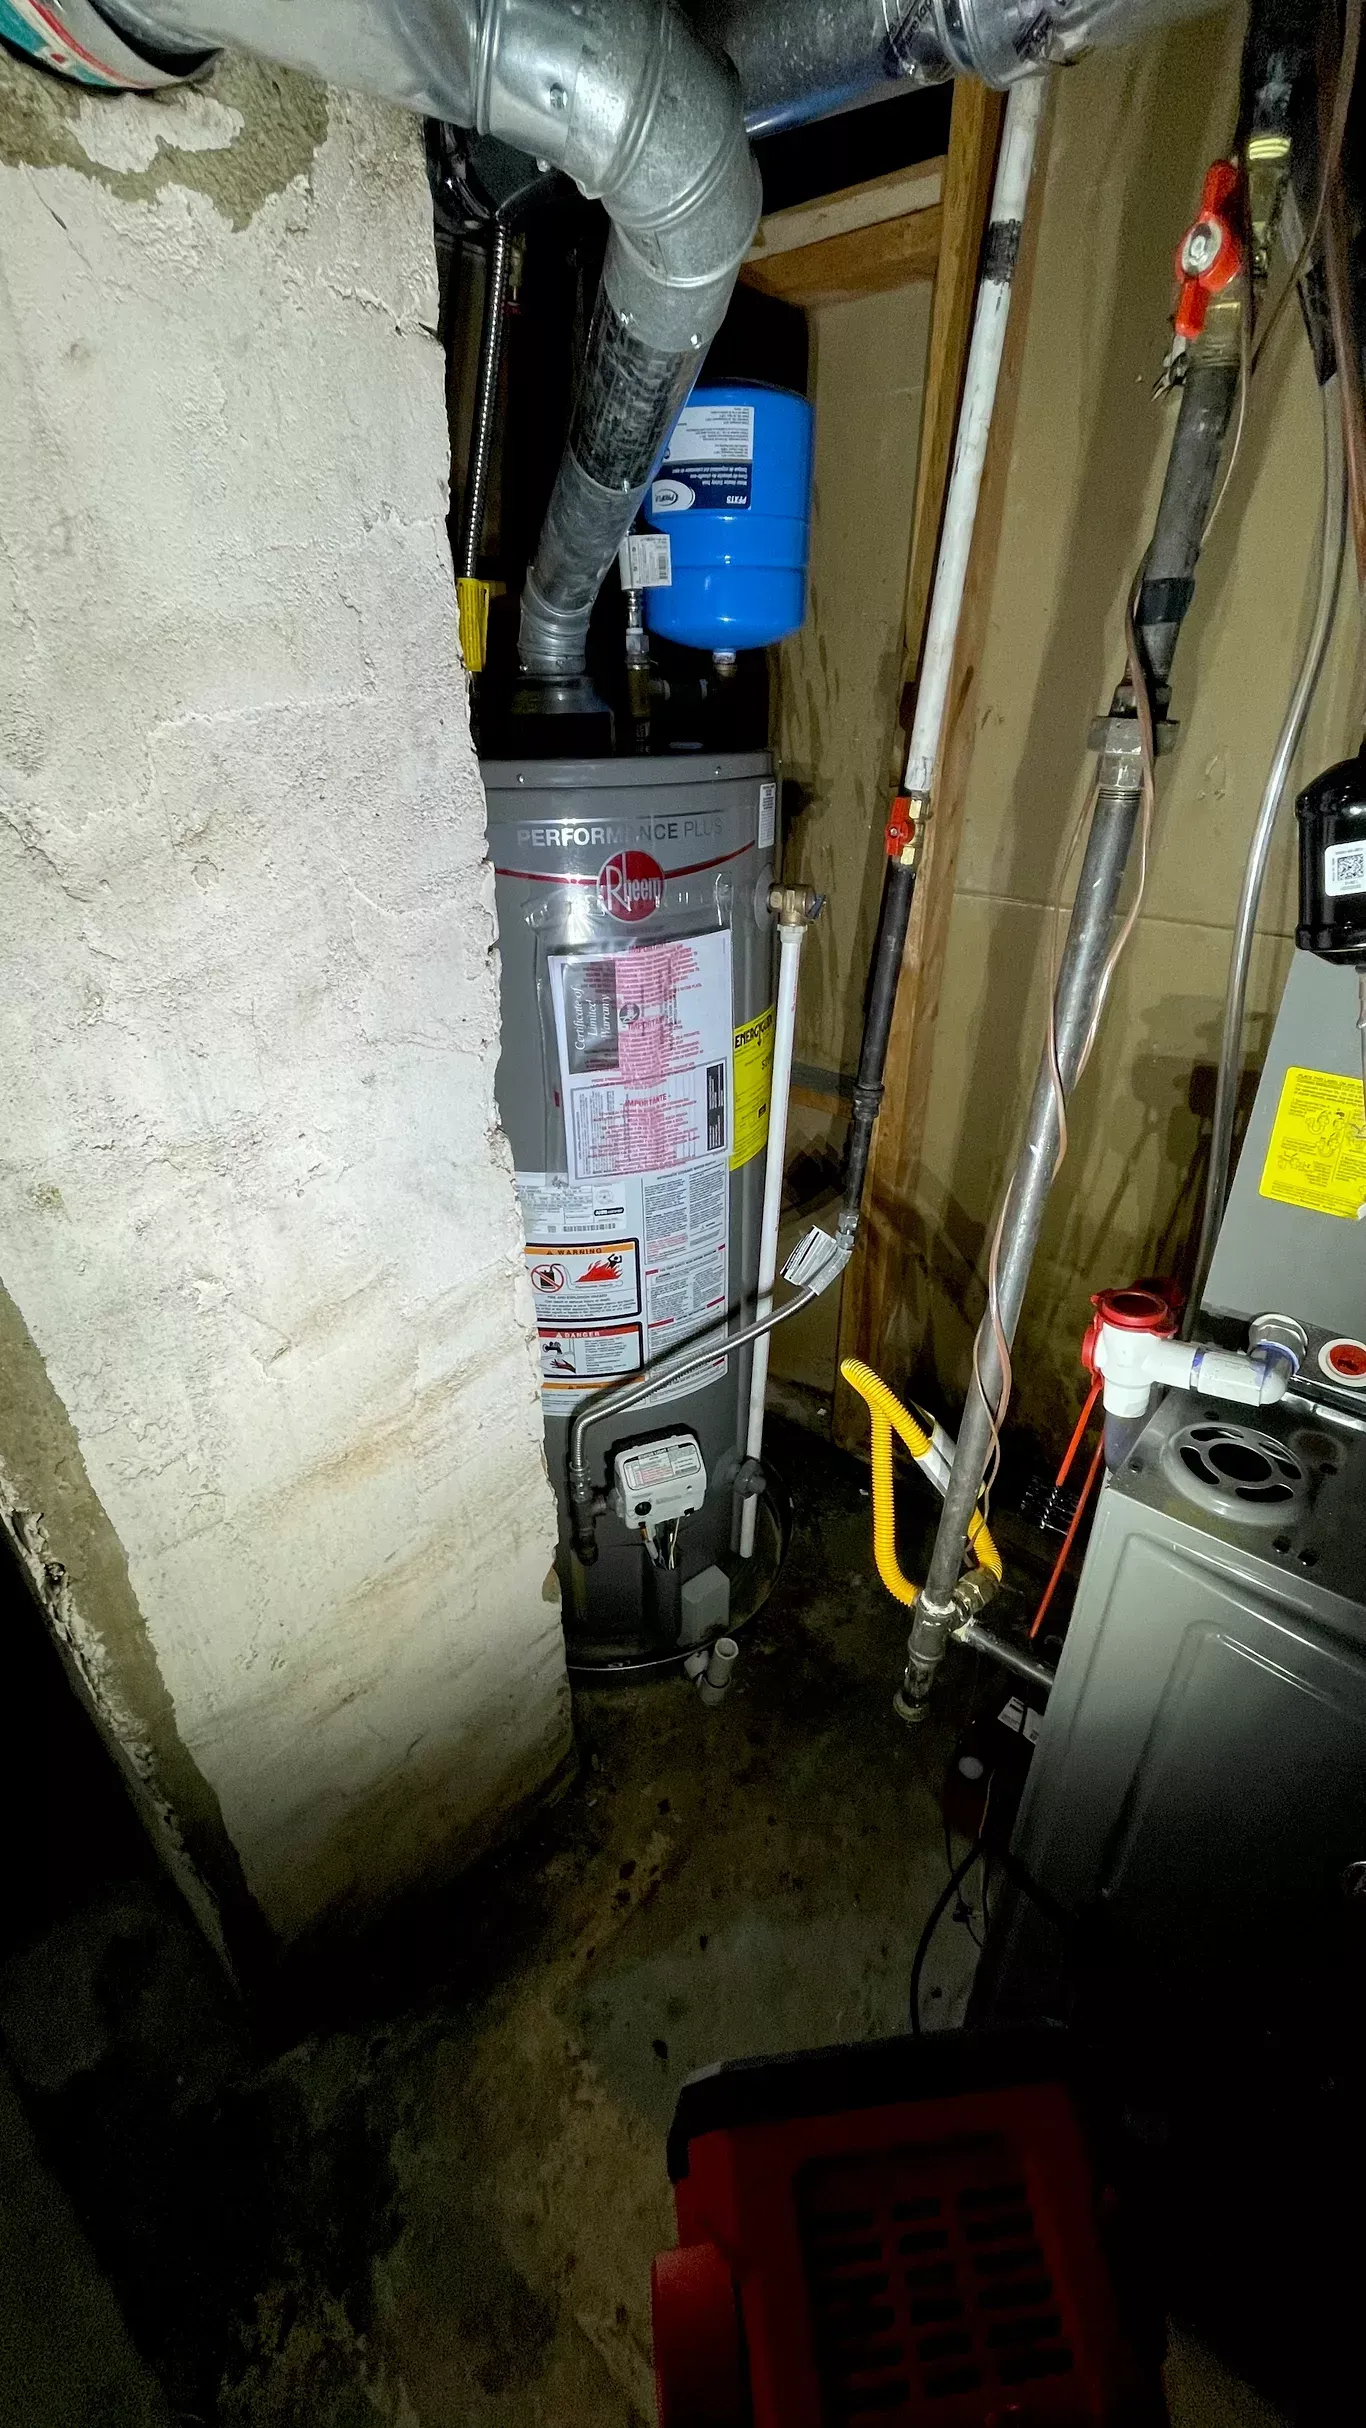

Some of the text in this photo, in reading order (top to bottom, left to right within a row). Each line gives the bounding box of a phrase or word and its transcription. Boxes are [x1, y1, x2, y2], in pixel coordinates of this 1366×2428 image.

[517, 817, 723, 847] PERFORMNCE PLUS
[606, 852, 663, 912] Rheem
[571, 985, 586, 1051] Certificate of
[585, 999, 598, 1036] Limited
[601, 994, 612, 1038] Warranty
[564, 1331, 600, 1339] DANGER
